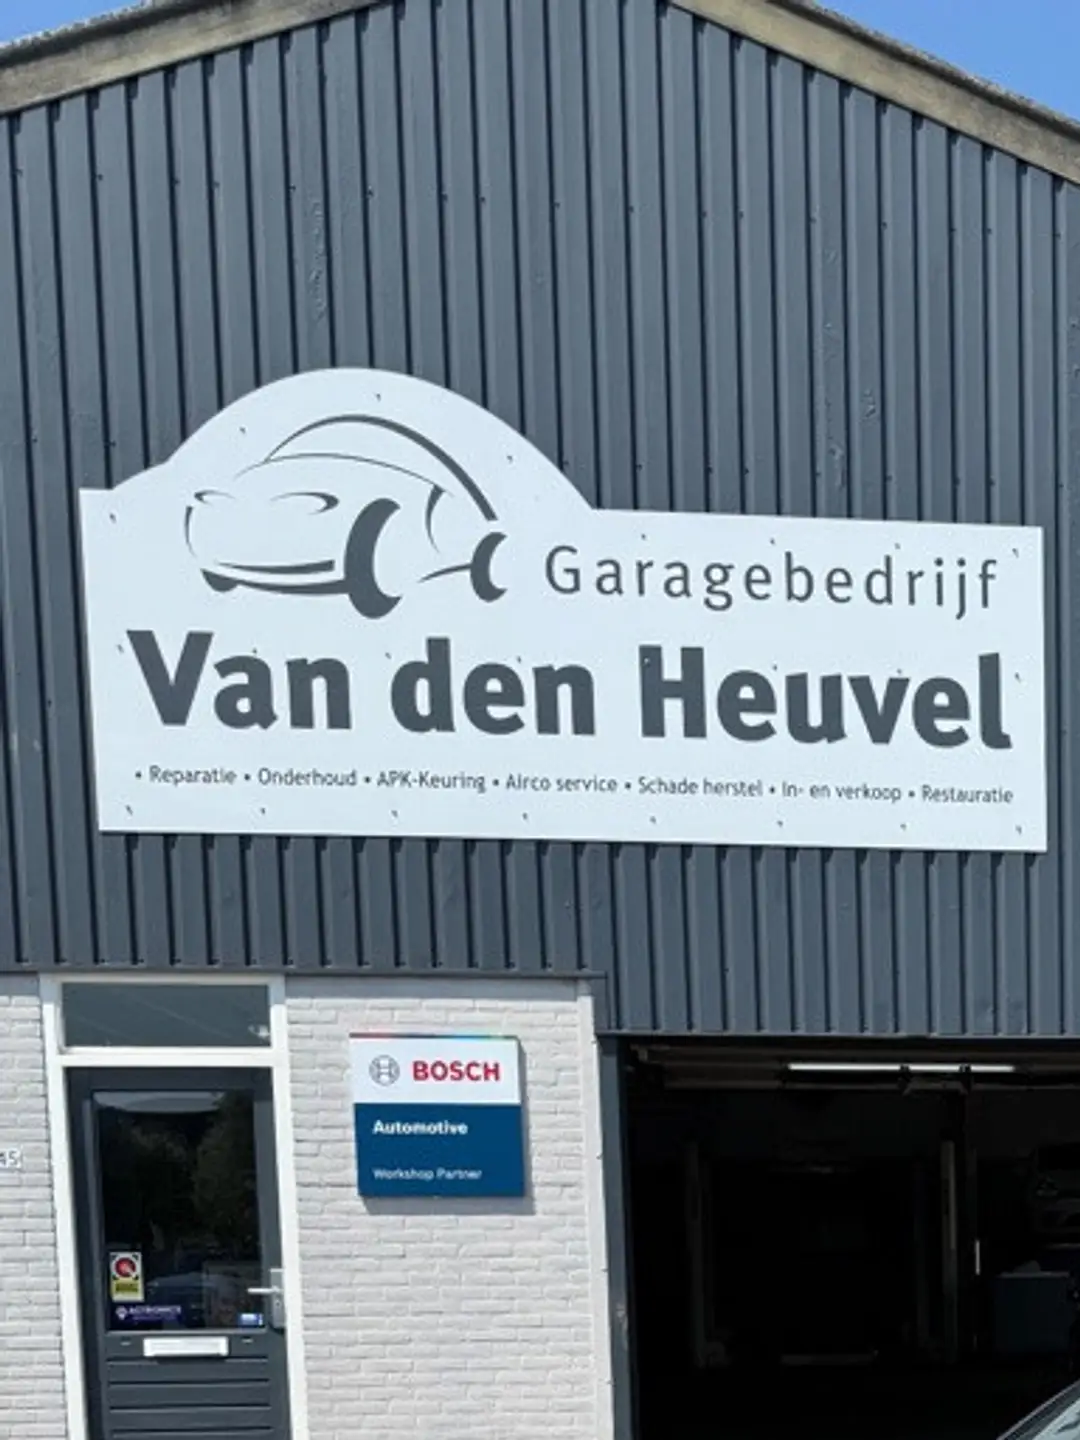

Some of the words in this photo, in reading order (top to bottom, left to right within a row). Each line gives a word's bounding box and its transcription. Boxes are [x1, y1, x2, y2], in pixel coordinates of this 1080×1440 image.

[545, 545, 998, 620] Garagebedrijf
[126, 629, 353, 731] Van
[389, 636, 597, 737] den
[638, 644, 1013, 750] Heuvel
[149, 764, 237, 786] Reparatie
[258, 767, 358, 787] Onderhoud
[376, 770, 487, 794] APK-Keuring
[505, 774, 551, 791] Airco
[556, 777, 618, 792] service
[637, 776, 699, 795] Schade
[703, 779, 763, 798] herstel
[782, 782, 804, 798] In-
[809, 785, 831, 799] en
[835, 784, 902, 802] verkoop
[921, 784, 1014, 804] Restauratie
[413, 1060, 501, 1082] BOSCH
[372, 1119, 469, 1135] Automotive
[372, 1168, 434, 1181] Workshop
[436, 1168, 483, 1180] Partner
